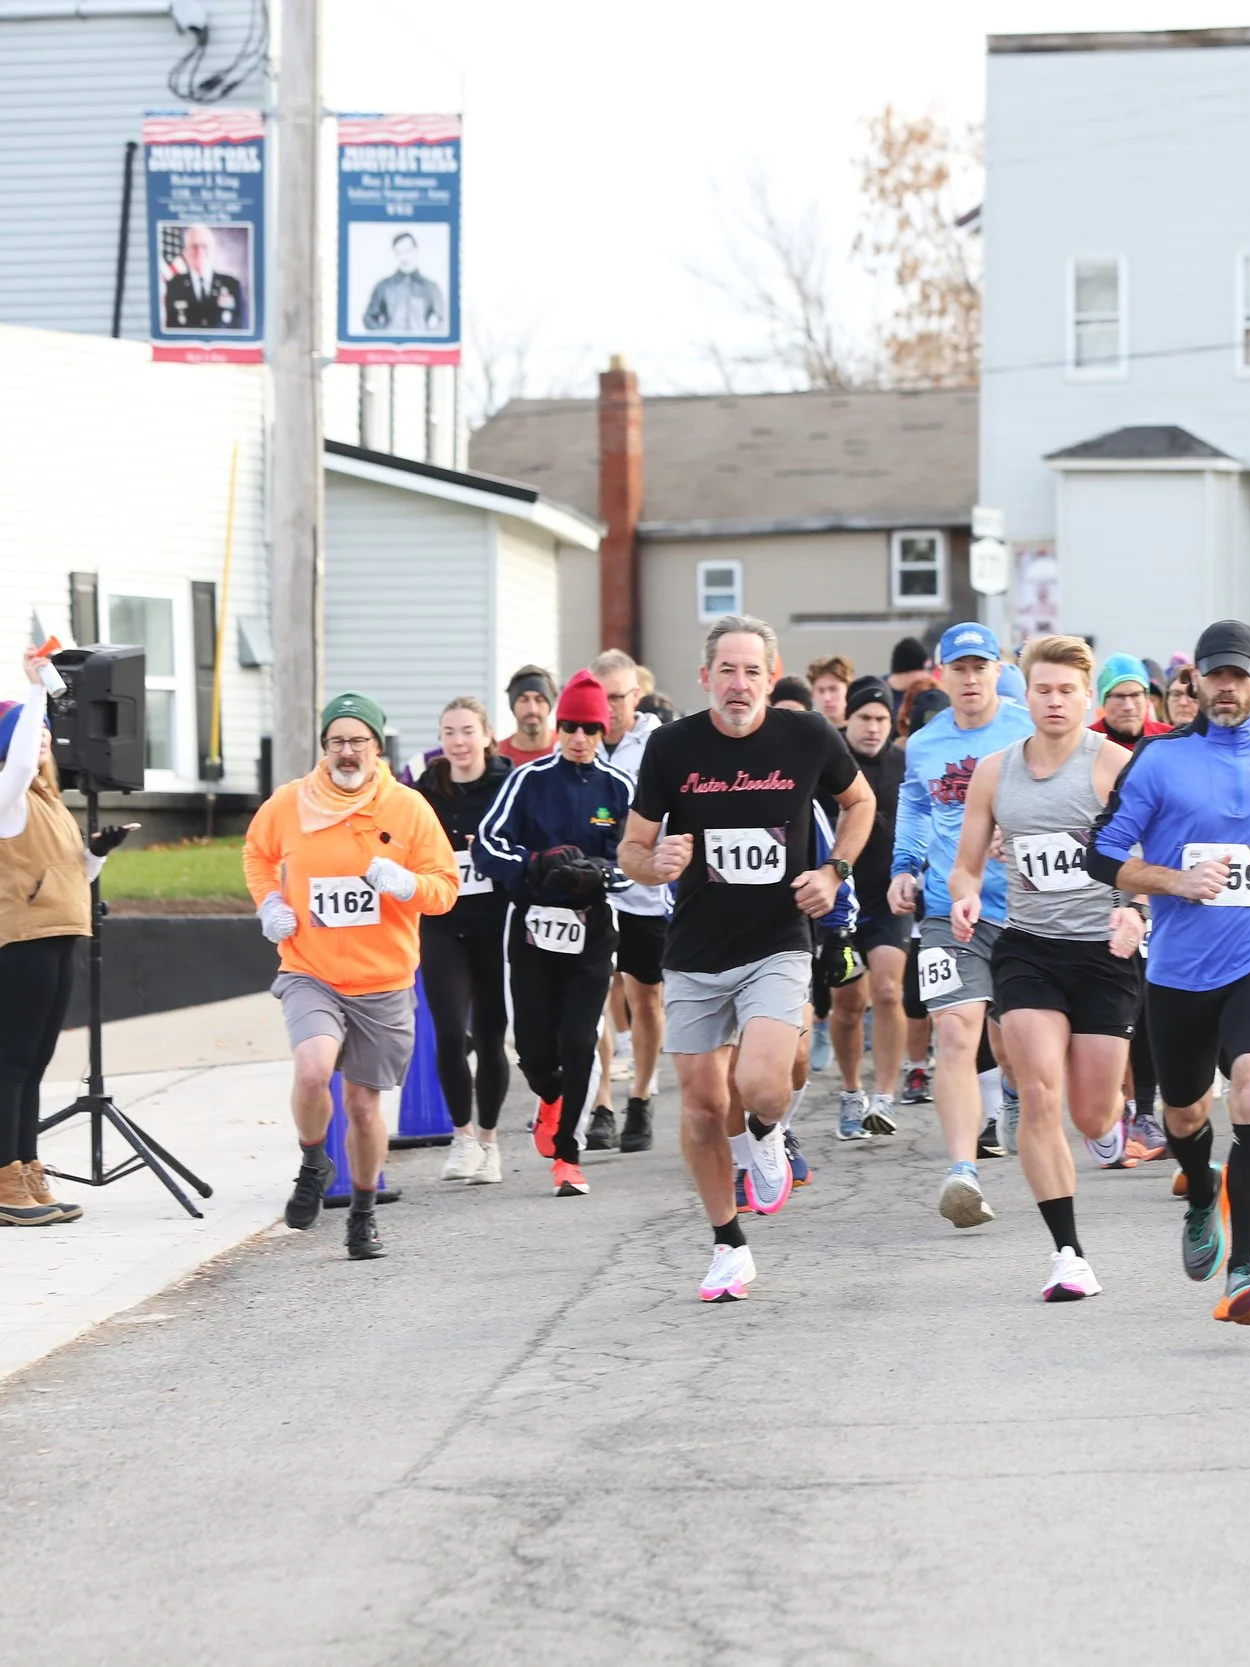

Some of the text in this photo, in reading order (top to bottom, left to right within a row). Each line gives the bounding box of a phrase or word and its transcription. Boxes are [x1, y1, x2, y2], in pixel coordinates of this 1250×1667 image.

[680, 770, 796, 793] Mister Goodbar
[712, 844, 780, 870] 1104
[1022, 847, 1086, 878] 1144
[314, 890, 374, 914] 1162
[531, 918, 580, 942] 1170
[919, 958, 951, 987] 153
